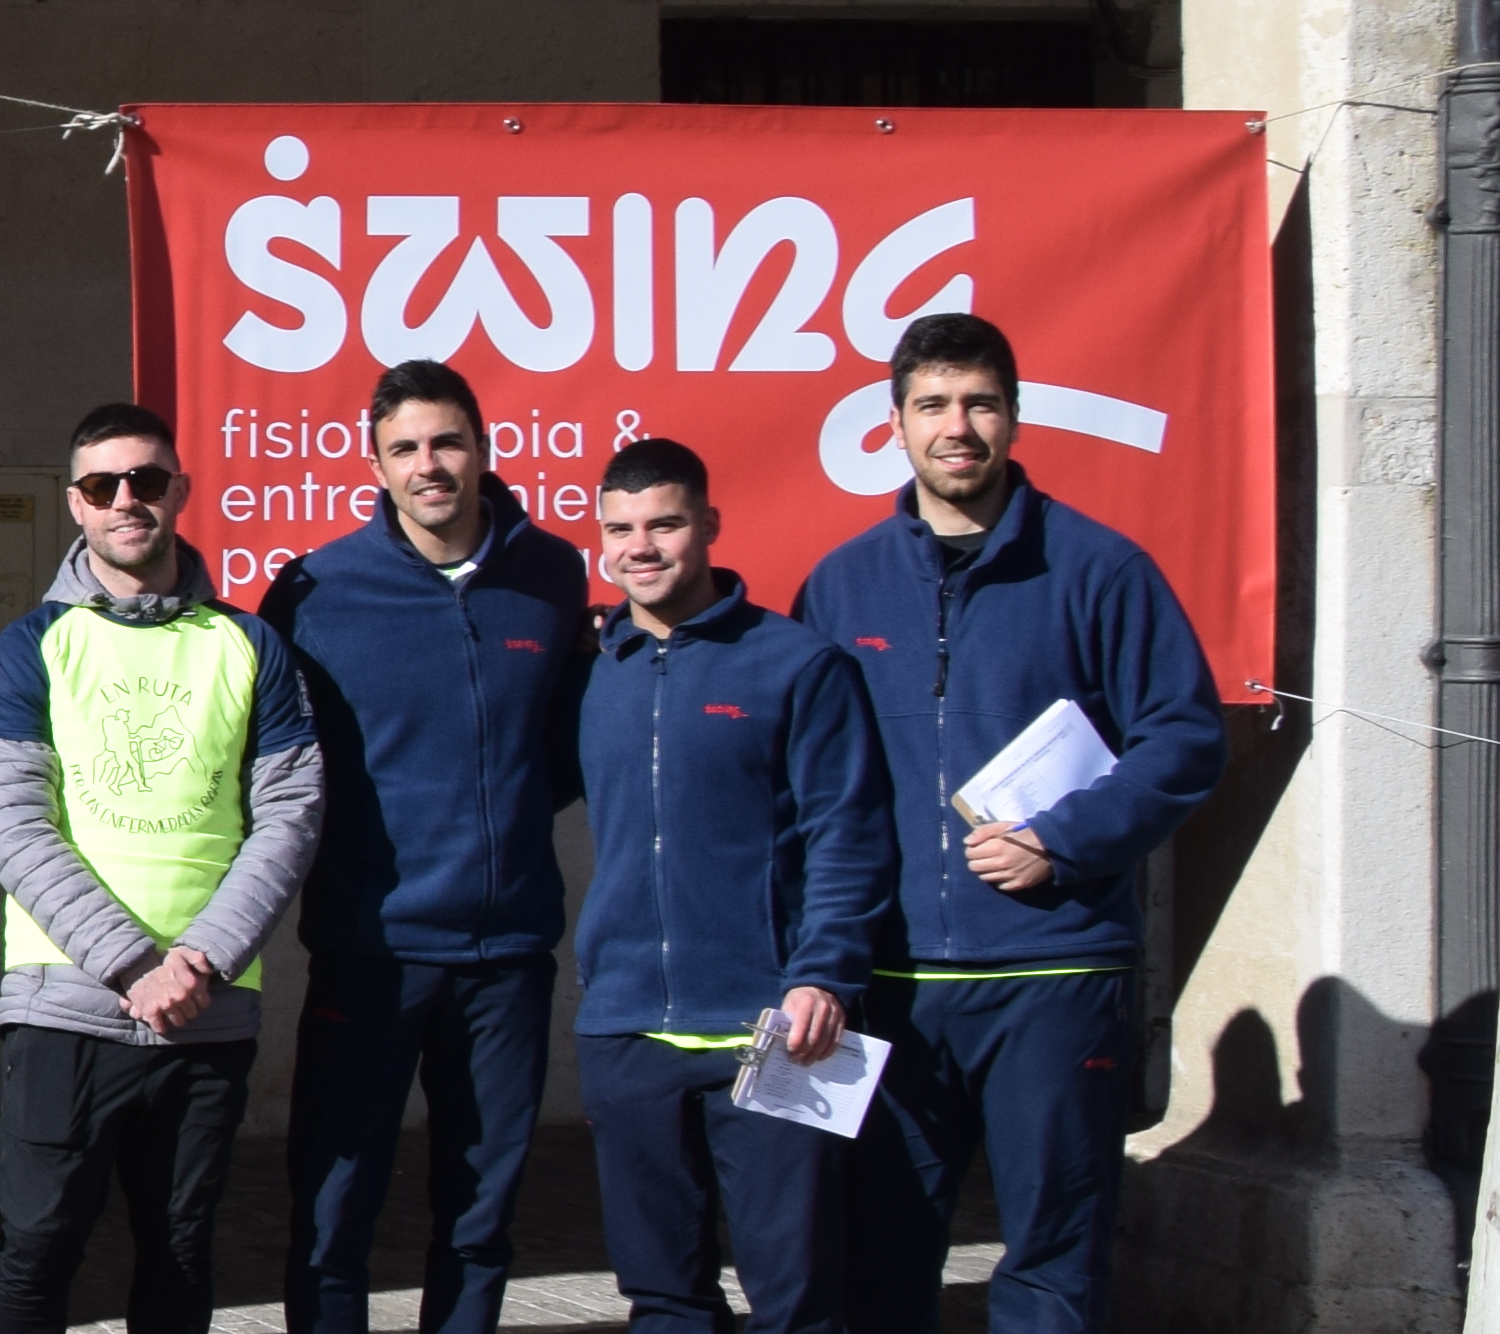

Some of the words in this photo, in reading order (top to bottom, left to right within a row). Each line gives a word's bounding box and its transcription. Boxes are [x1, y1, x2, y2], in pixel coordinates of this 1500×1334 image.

[222, 135, 1167, 496] swing
[221, 409, 583, 468] fisiotpia
[614, 409, 650, 451] &
[100, 678, 131, 705] EN
[138, 676, 193, 707] RUTA
[69, 764, 85, 790] POR
[78, 789, 101, 816] LAS
[100, 806, 205, 835] ENFERMEDADES
[201, 767, 225, 809] RARAS
